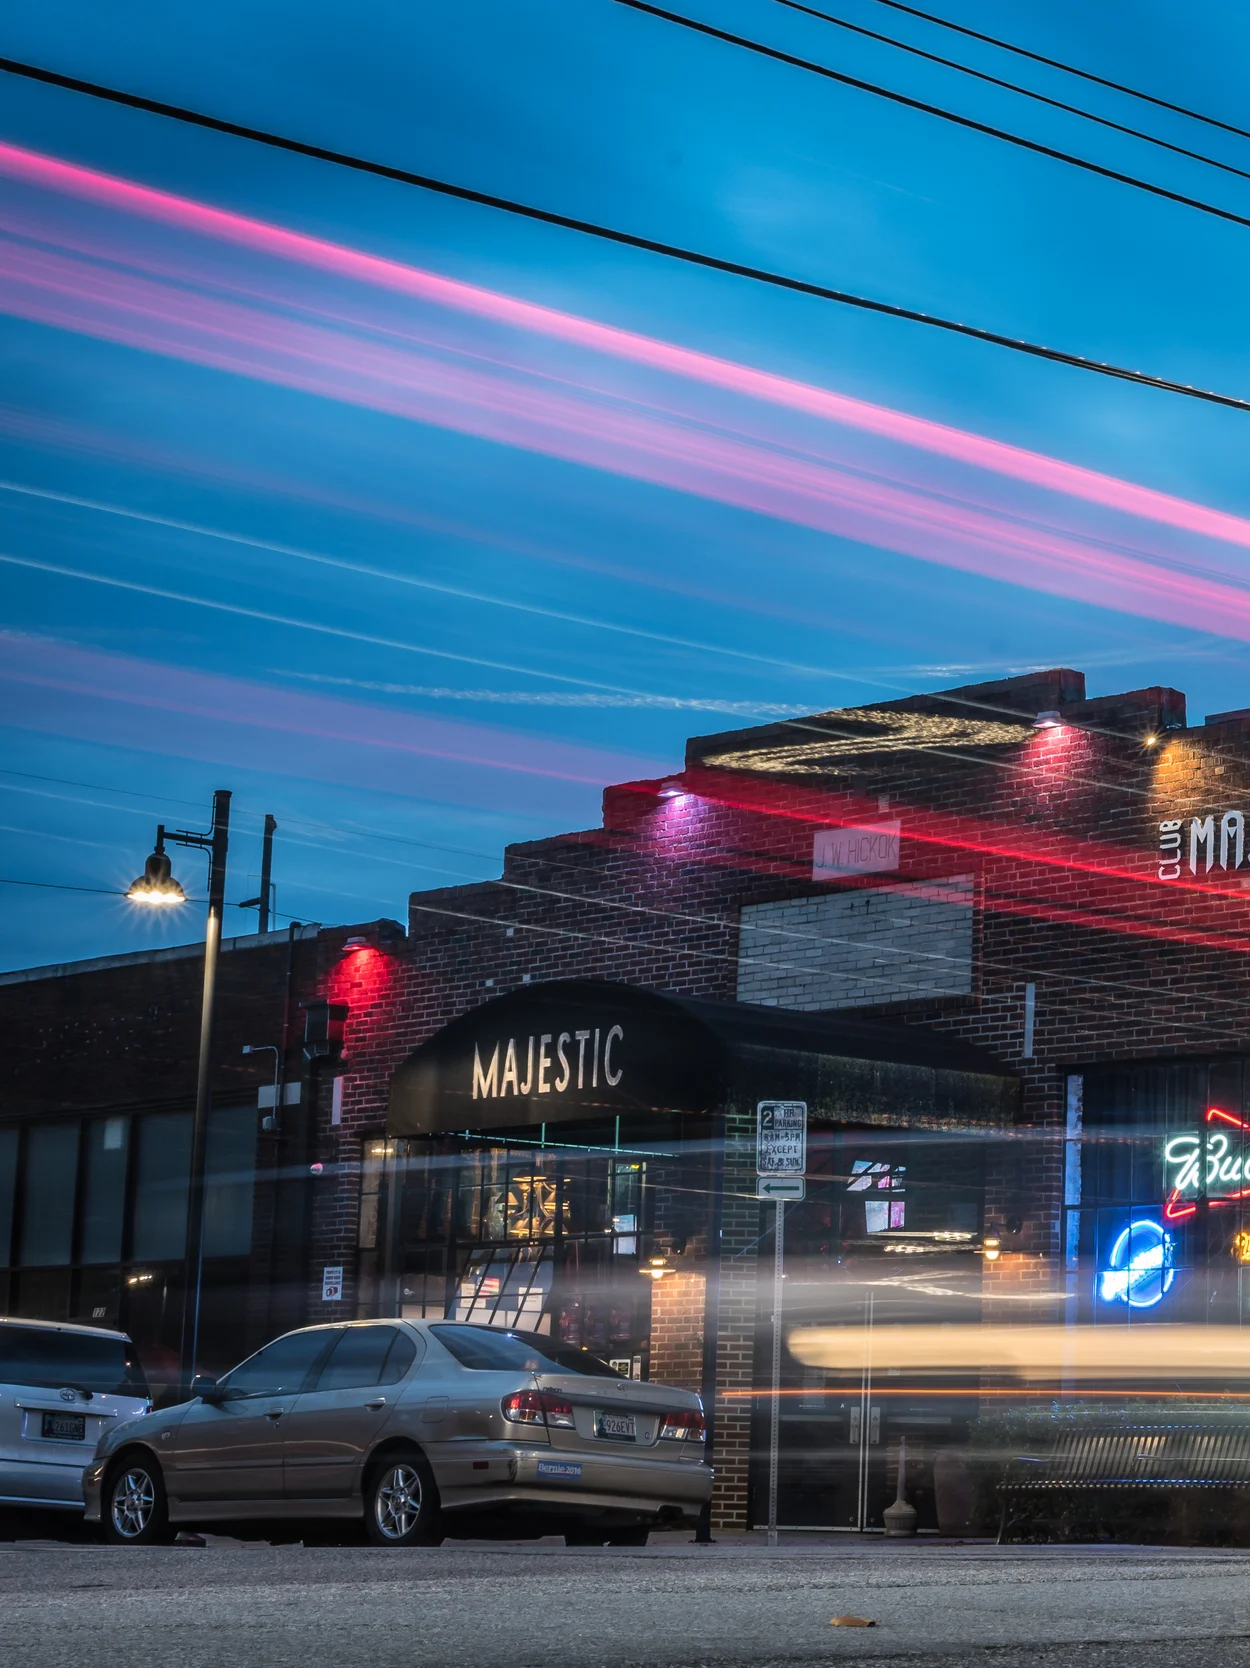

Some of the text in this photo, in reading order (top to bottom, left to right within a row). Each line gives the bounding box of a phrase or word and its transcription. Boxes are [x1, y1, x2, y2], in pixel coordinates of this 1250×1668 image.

[815, 833, 896, 868] J. W. HICKOK
[1158, 818, 1182, 880] CLUB
[472, 1024, 624, 1100] MAJESTIC
[763, 1111, 772, 1126] 2
[784, 1109, 795, 1117] HR
[775, 1119, 802, 1127] PARKING
[767, 1145, 797, 1154] EXCEPT
[538, 1462, 582, 1476] Bernie 2016
